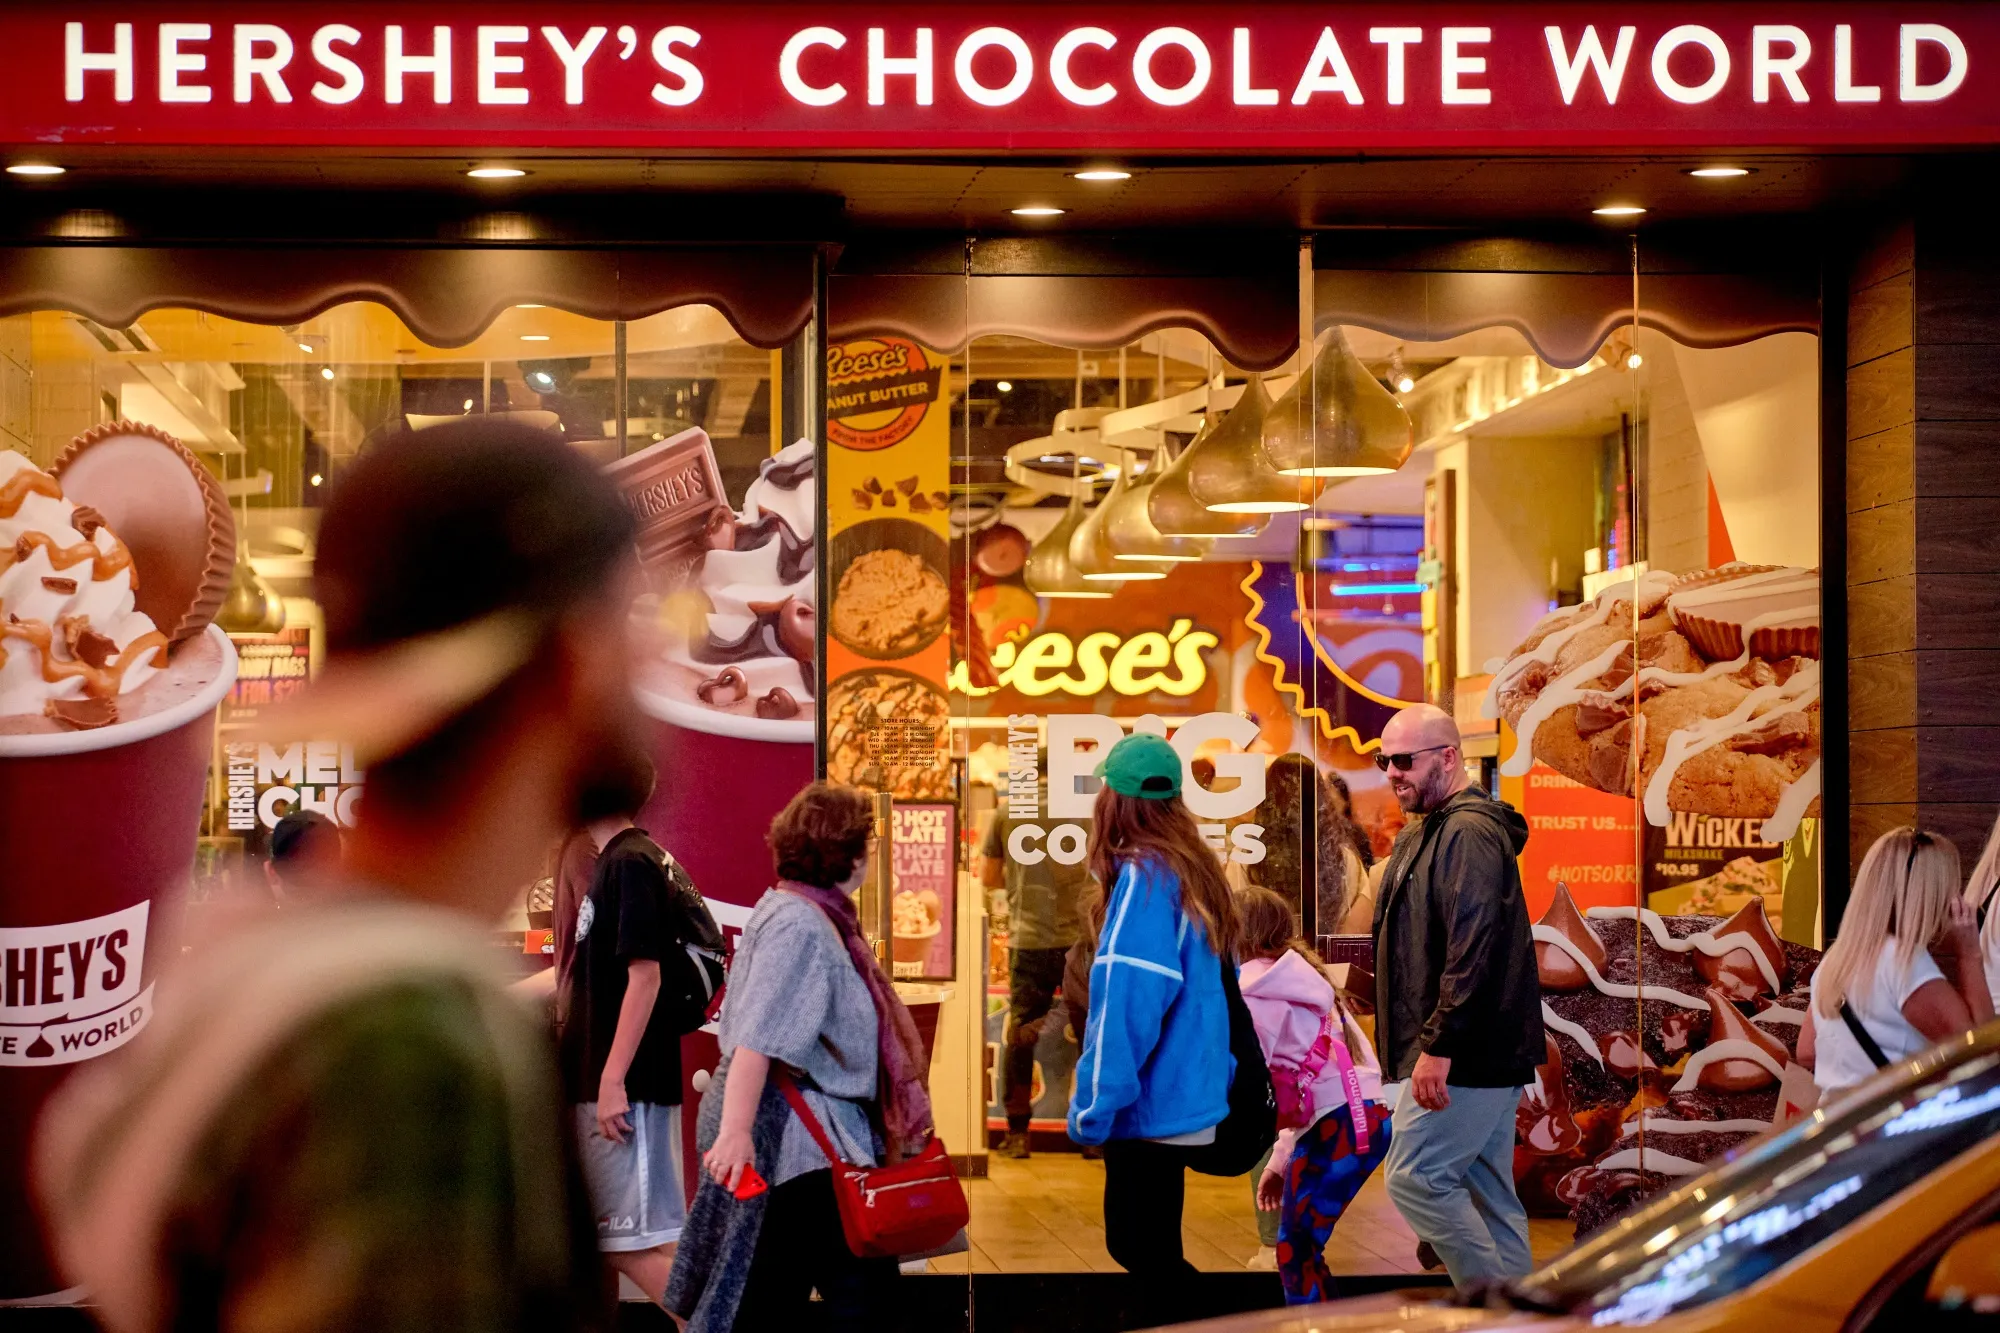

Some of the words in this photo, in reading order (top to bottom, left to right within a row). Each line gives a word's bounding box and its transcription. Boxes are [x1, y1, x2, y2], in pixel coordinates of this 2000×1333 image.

[66, 22, 704, 106] HERSHEY'S
[779, 26, 1491, 106] CHOCOLATE
[1544, 24, 1968, 105] WORLD
[827, 392, 866, 410] ANUT
[870, 381, 928, 402] BUTTER
[257, 741, 368, 784] MEL
[1008, 713, 1039, 819] HERSHEY'S
[1047, 711, 1266, 820] BG
[228, 742, 255, 830] HERSHEY'S
[257, 786, 368, 830] CHO
[904, 810, 947, 827] HOT
[1530, 816, 1588, 830] TRUST
[904, 844, 945, 860] HOT
[1008, 823, 1267, 866] COES
[1655, 863, 1699, 877] $10.95
[0, 929, 129, 1008] HEY'S
[61, 1006, 144, 1052] WORLD
[1346, 1069, 1368, 1134] lululemon
